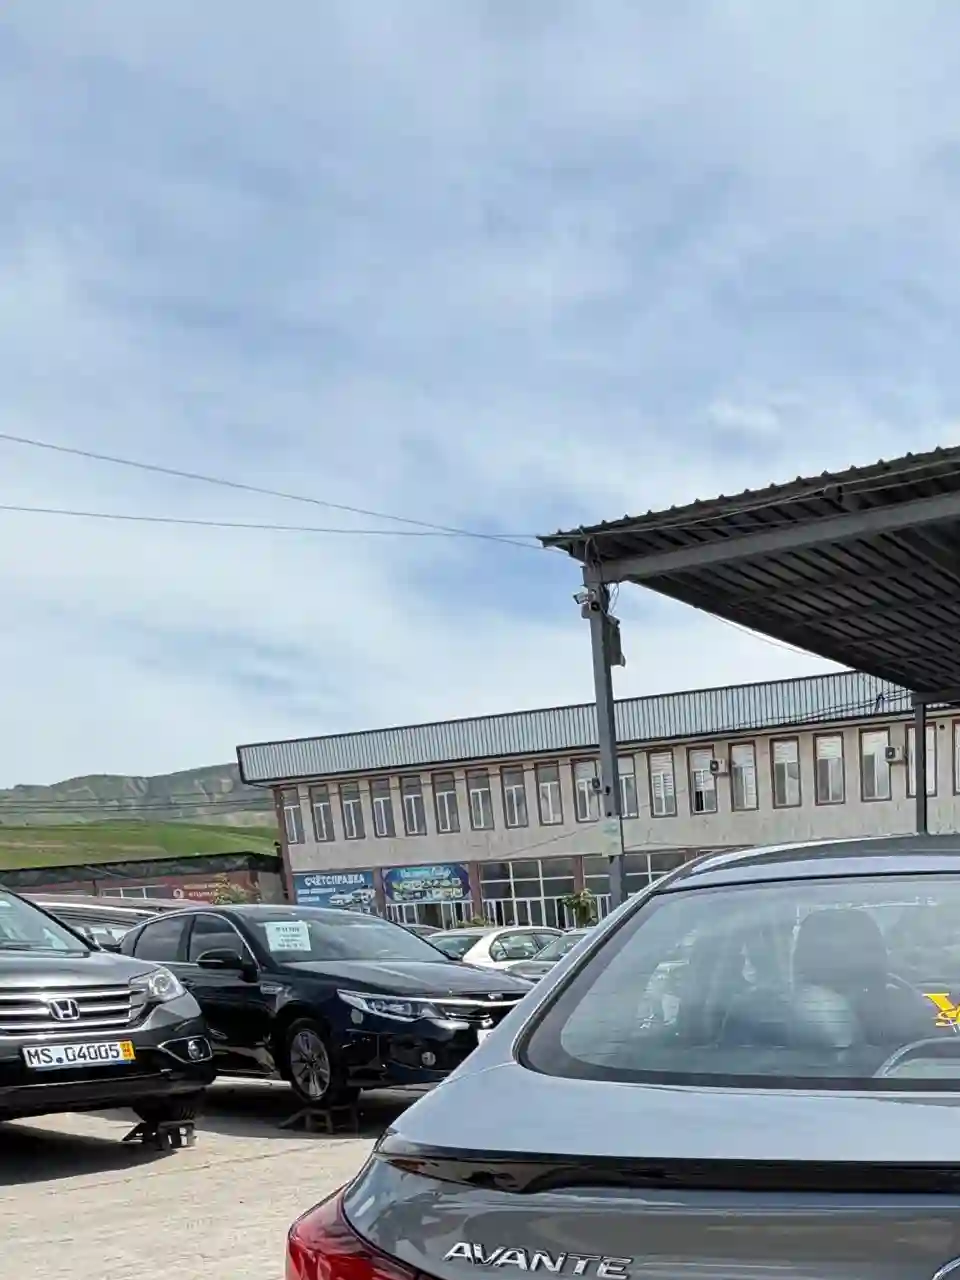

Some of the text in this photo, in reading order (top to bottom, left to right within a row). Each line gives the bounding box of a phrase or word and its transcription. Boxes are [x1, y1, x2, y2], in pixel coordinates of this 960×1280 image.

[26, 1047, 54, 1066] MS
[63, 1043, 120, 1062] 04005
[442, 1242, 633, 1280] AVANTE
